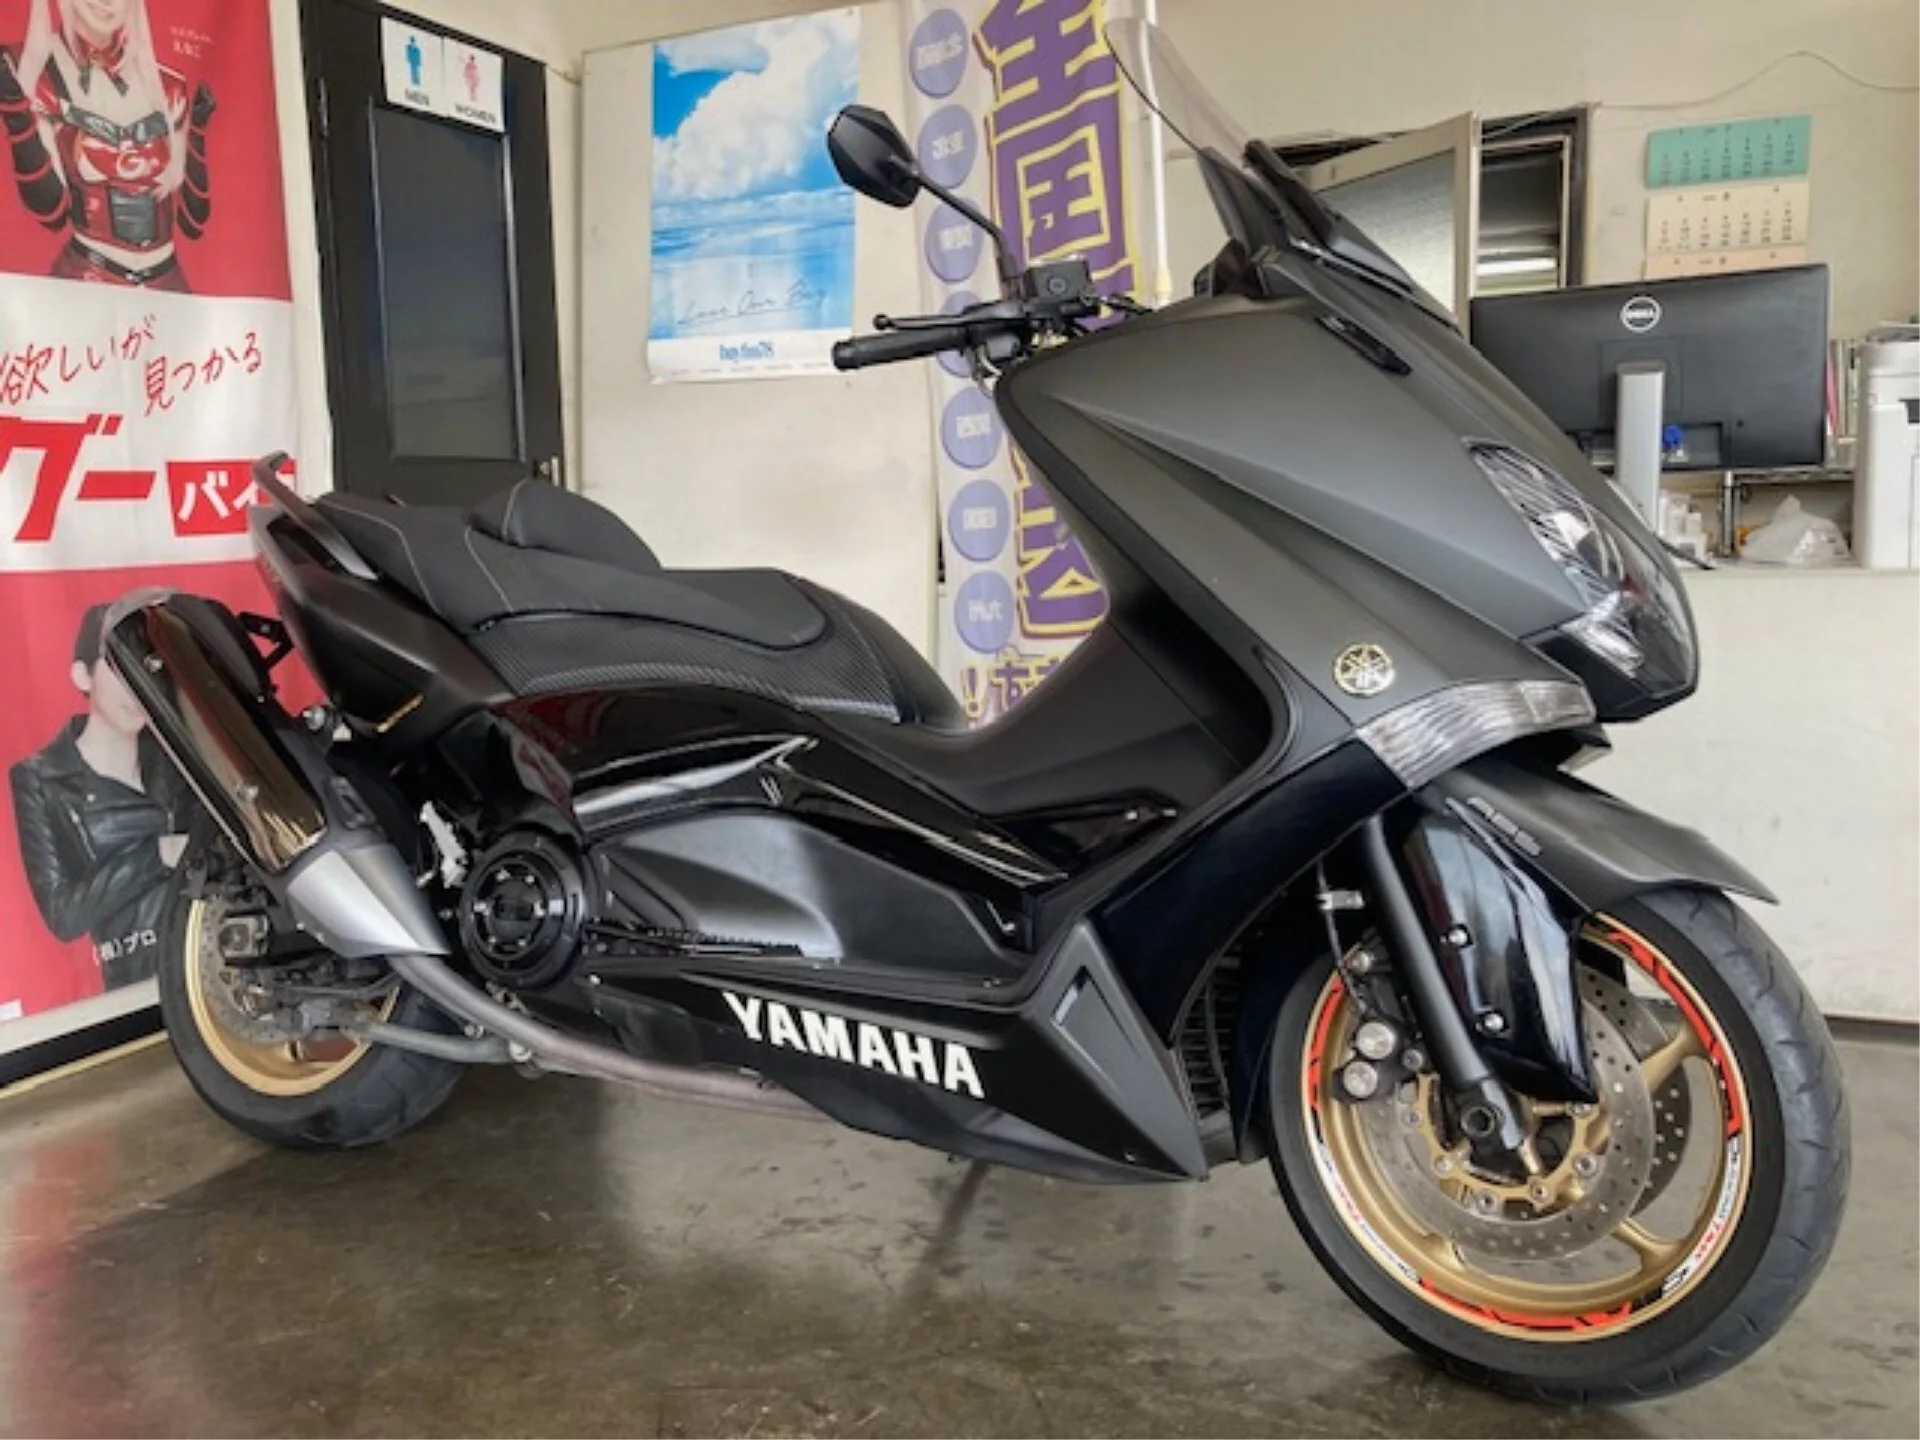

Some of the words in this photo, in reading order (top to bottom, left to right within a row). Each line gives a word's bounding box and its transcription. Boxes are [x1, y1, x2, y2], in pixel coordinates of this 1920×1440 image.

[144, 331, 262, 417] 見つかる
[0, 413, 157, 542] グー
[722, 991, 985, 1098] YAMAHA
